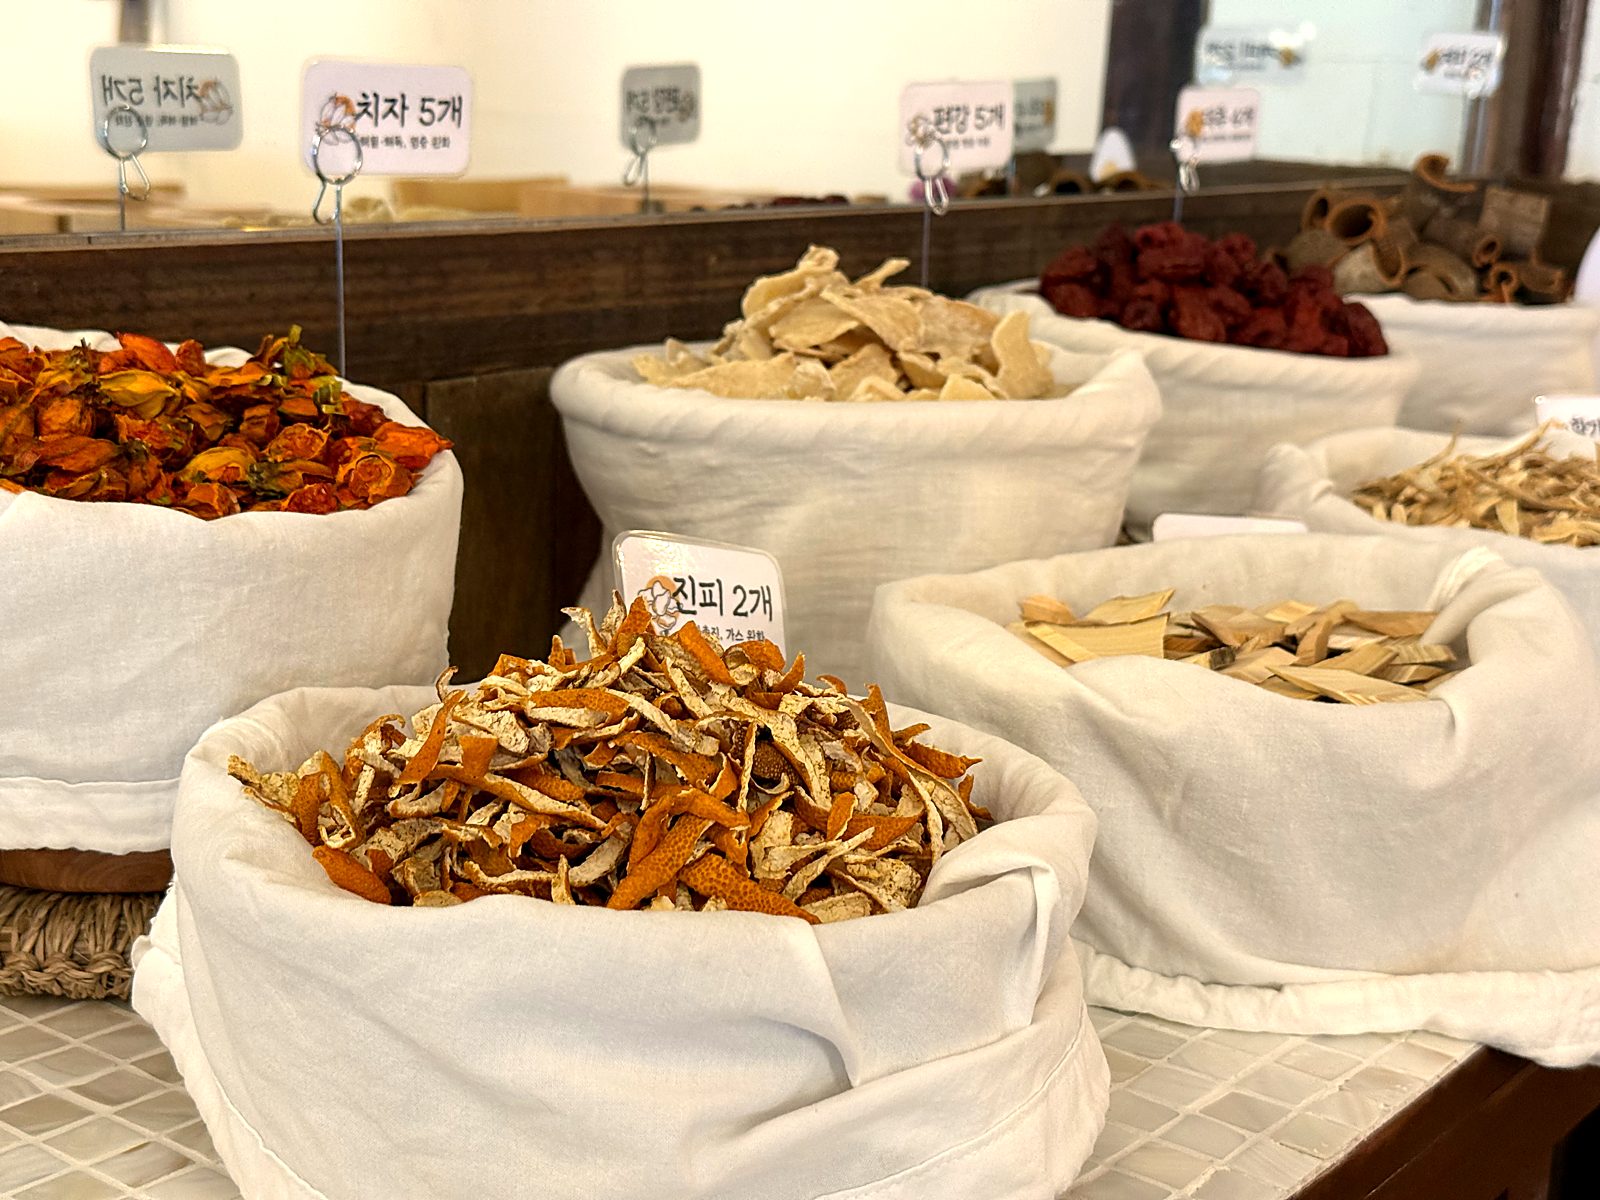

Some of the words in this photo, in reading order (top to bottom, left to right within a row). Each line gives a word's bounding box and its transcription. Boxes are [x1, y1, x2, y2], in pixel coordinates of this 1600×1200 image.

[354, 92, 409, 128] 치자
[419, 95, 463, 128] 5개
[933, 104, 970, 134] 편강
[975, 103, 1004, 130] 5개
[672, 575, 723, 616] 진피
[733, 585, 772, 622] 2개
[726, 627, 744, 641] 가스
